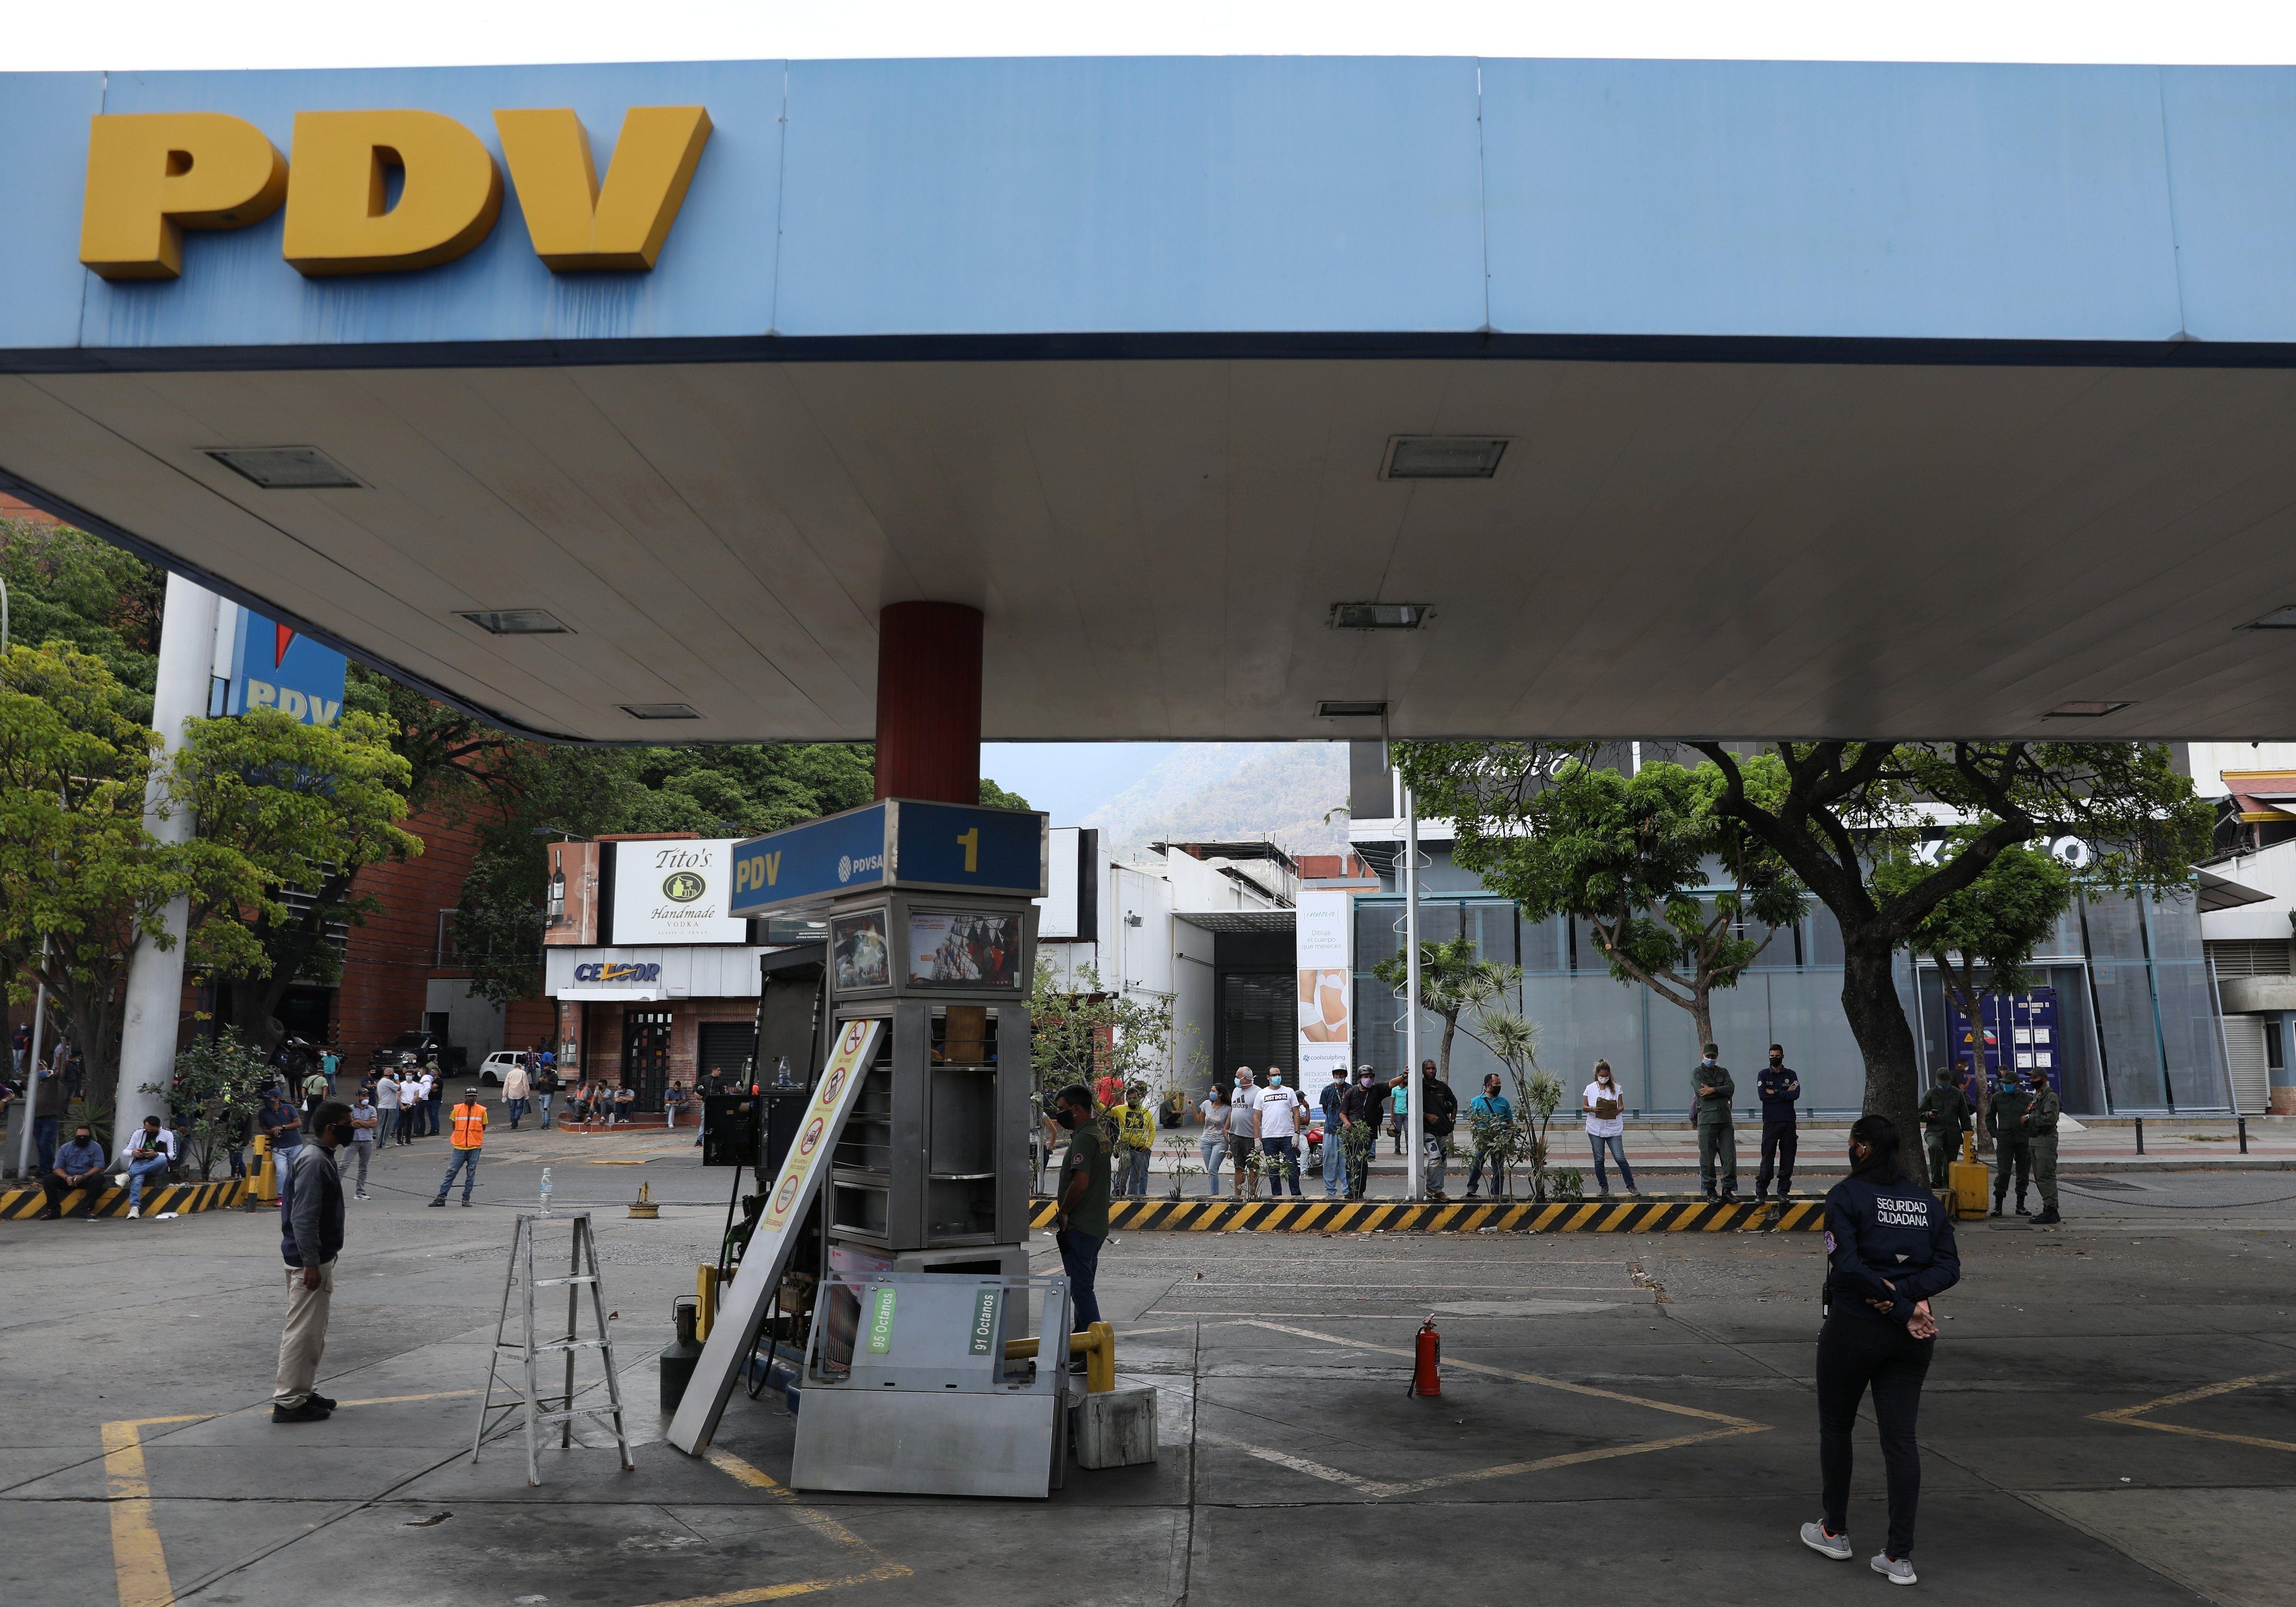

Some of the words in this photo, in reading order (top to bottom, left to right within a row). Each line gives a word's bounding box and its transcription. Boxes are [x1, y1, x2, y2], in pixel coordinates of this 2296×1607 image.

[79, 105, 714, 279] PDV
[246, 679, 340, 725] PDV
[655, 848, 712, 868] Tito's
[957, 828, 978, 872] 1
[737, 851, 781, 893] PDV
[853, 854, 884, 873] PDVSA
[651, 905, 715, 919] Handmade
[1877, 1197, 1927, 1213] SEGURIDAD
[766, 1218, 783, 1227] SEGURIDAD
[1878, 1211, 1929, 1227] CIUDADANA
[875, 1293, 893, 1333] Octanos
[977, 1294, 994, 1335] Octanos
[872, 1335, 886, 1348] 95
[974, 1338, 987, 1350] 91
